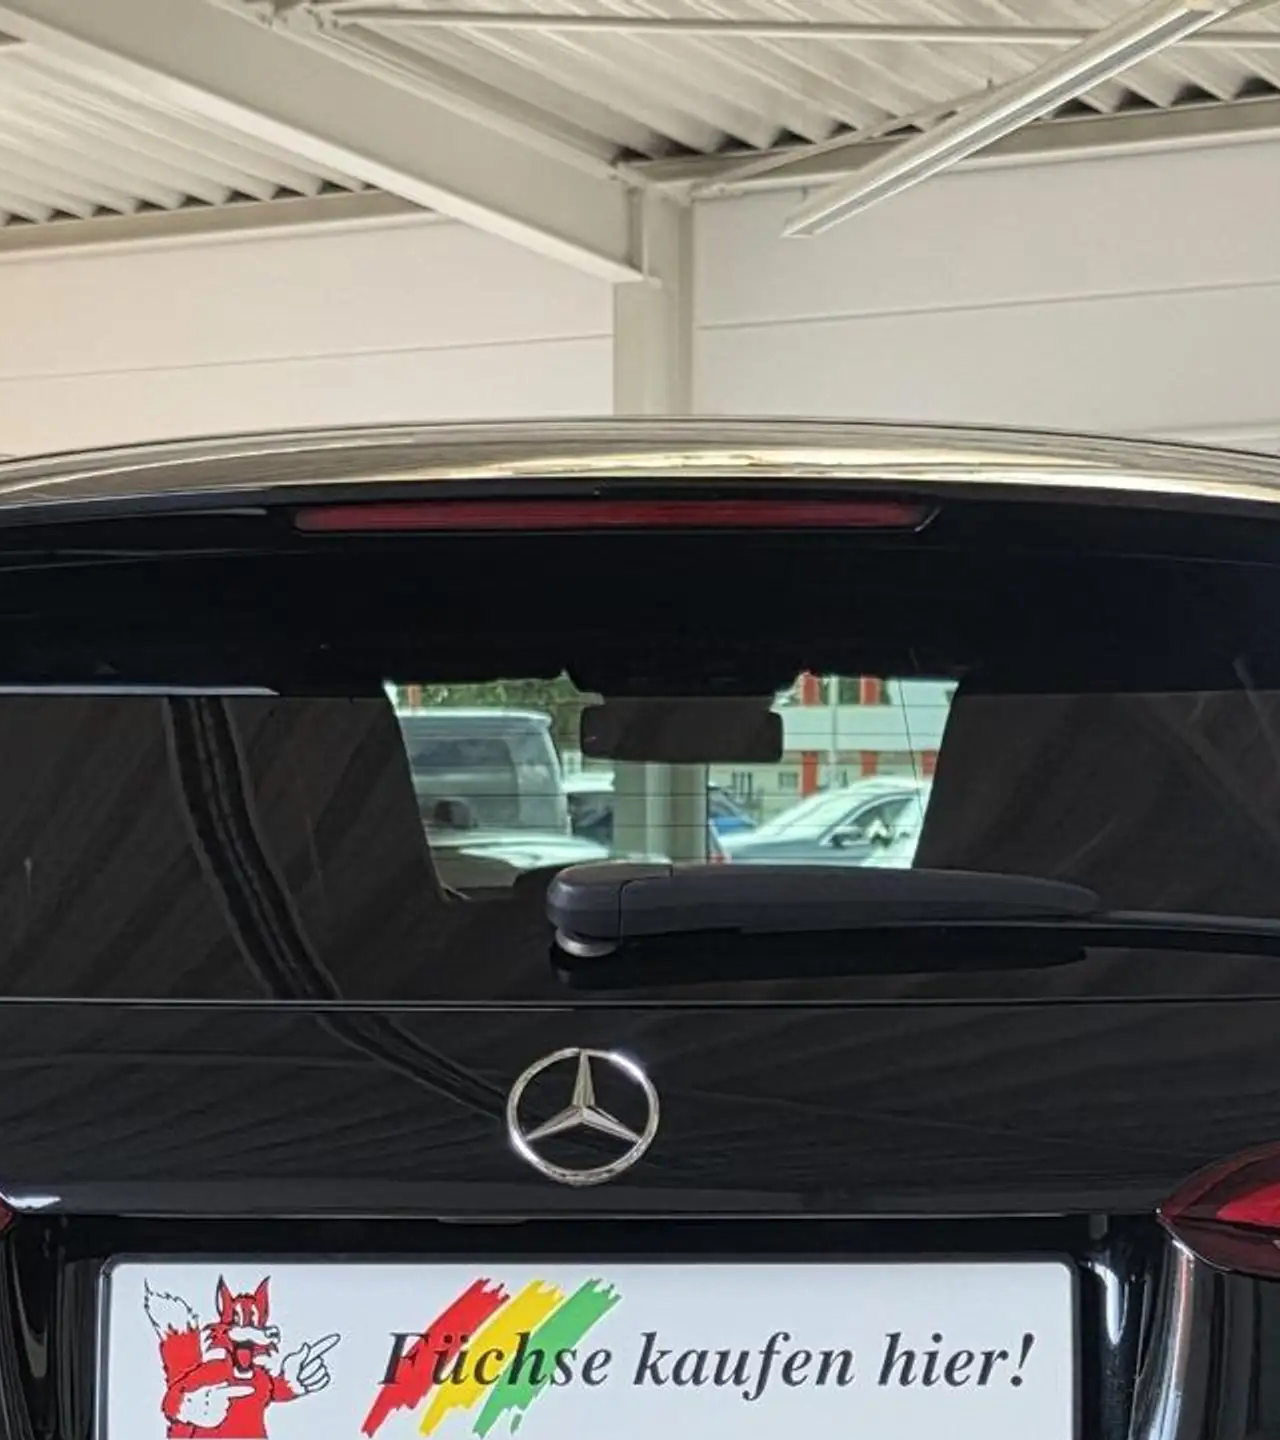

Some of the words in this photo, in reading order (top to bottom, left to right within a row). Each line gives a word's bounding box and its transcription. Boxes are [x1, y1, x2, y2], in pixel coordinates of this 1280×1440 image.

[377, 1331, 613, 1387] Füchse
[632, 1330, 856, 1402] kaufen
[877, 1331, 1036, 1388] hier!
